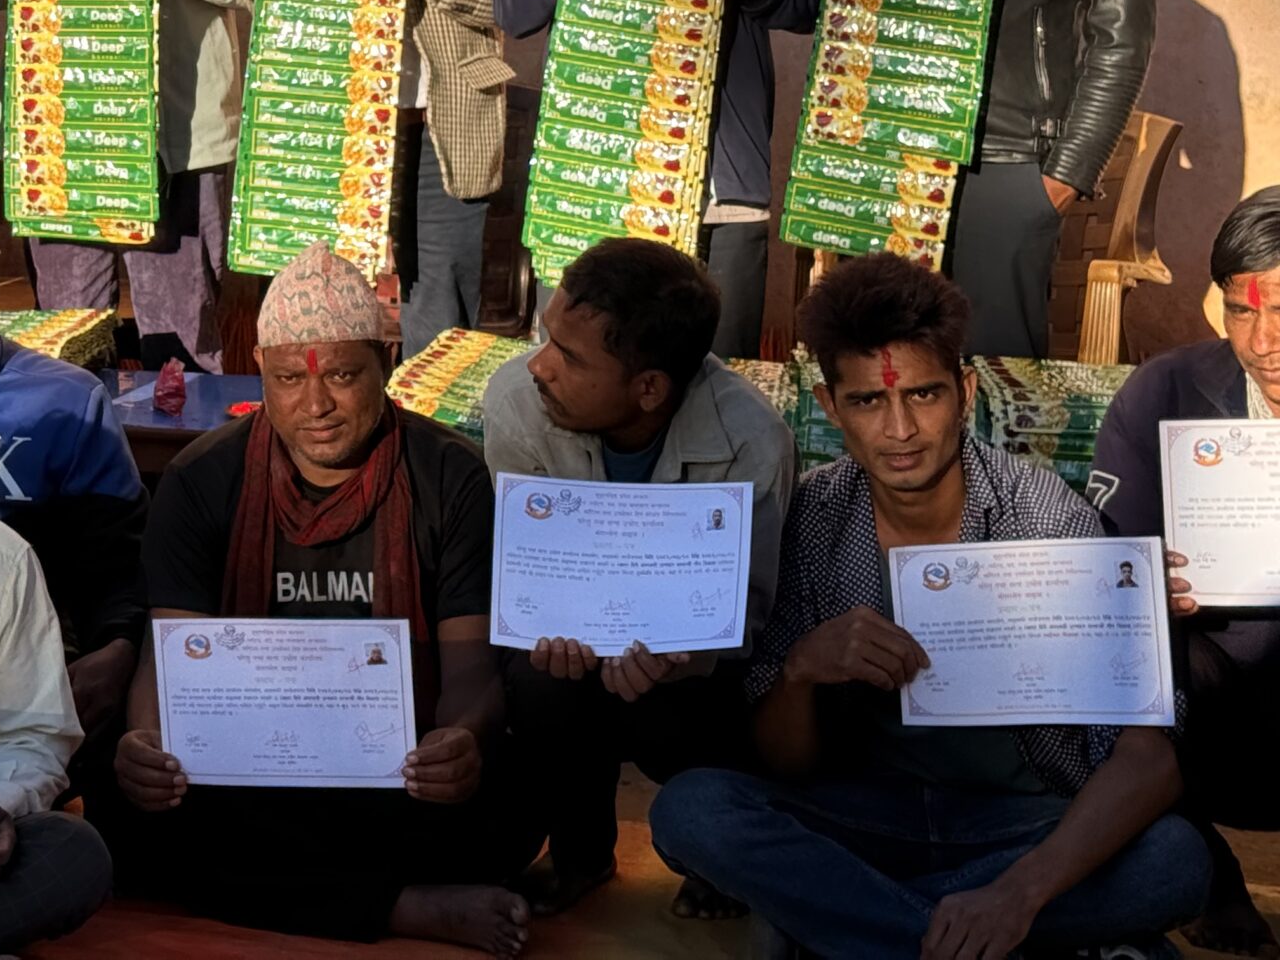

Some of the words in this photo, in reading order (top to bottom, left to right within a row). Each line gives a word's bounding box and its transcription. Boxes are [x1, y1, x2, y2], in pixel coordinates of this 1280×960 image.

[90, 10, 122, 23] Deep
[91, 41, 125, 54] Deep
[576, 73, 613, 90] Deep
[93, 102, 126, 116] Deep
[571, 105, 607, 122] Deep
[94, 134, 127, 147] Deep
[96, 195, 129, 209] Deep
[818, 200, 856, 217] Deep
[552, 234, 589, 250] Deep
[813, 231, 851, 248] Deep
[276, 571, 373, 603] BALMAI
